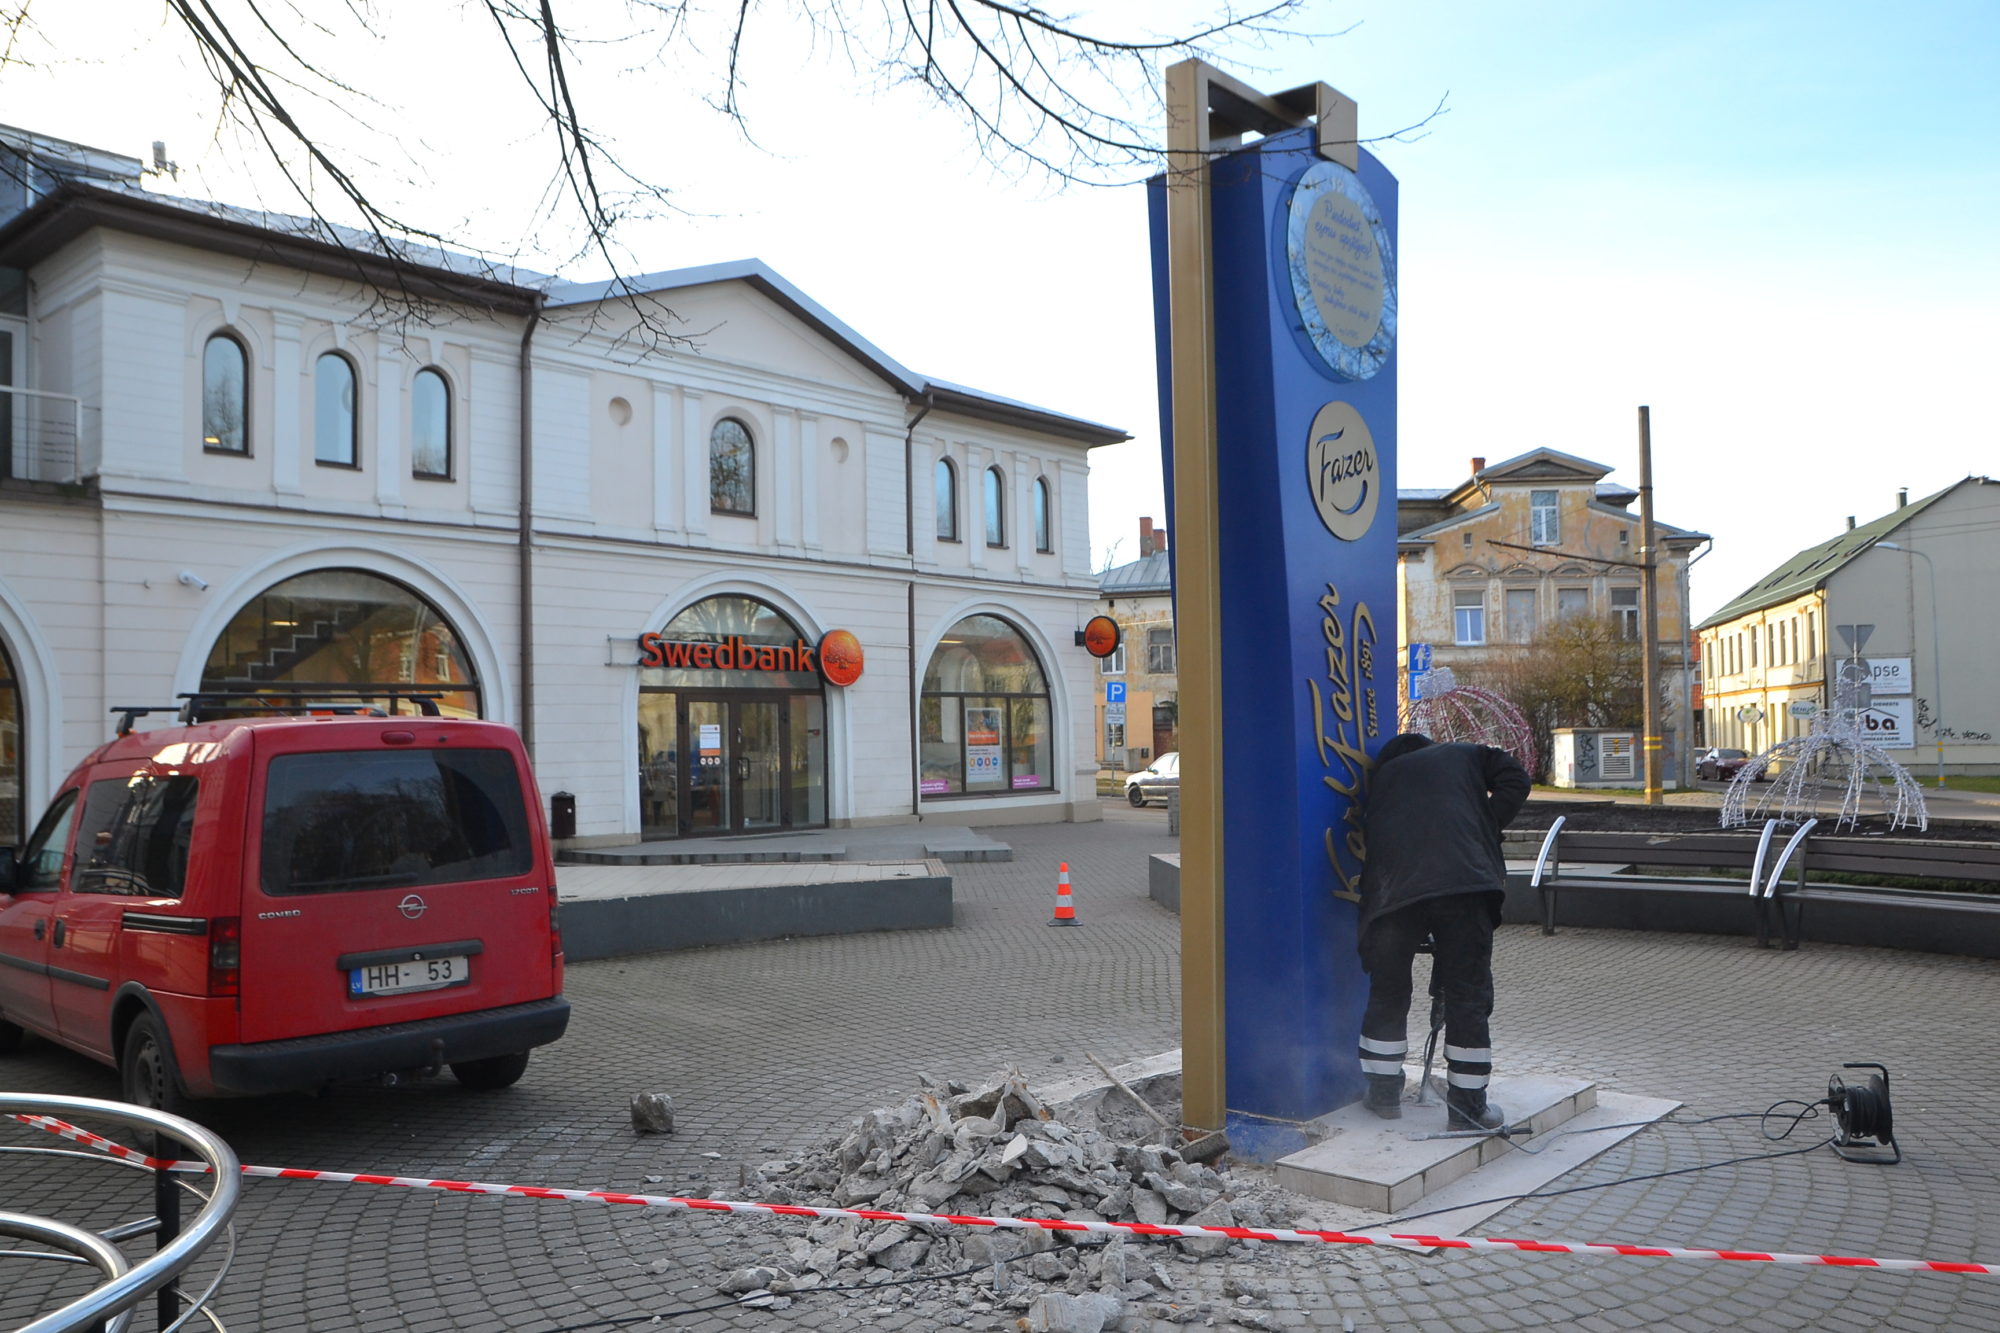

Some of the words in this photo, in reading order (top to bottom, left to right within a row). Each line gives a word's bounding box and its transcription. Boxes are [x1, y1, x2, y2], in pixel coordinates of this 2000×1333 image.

[1316, 427, 1374, 503] Fazer
[640, 632, 815, 672] Swedbank
[1359, 639, 1374, 681] 1891
[1111, 683, 1123, 701] P
[1307, 582, 1375, 786] Fazer
[1366, 688, 1379, 738] Since
